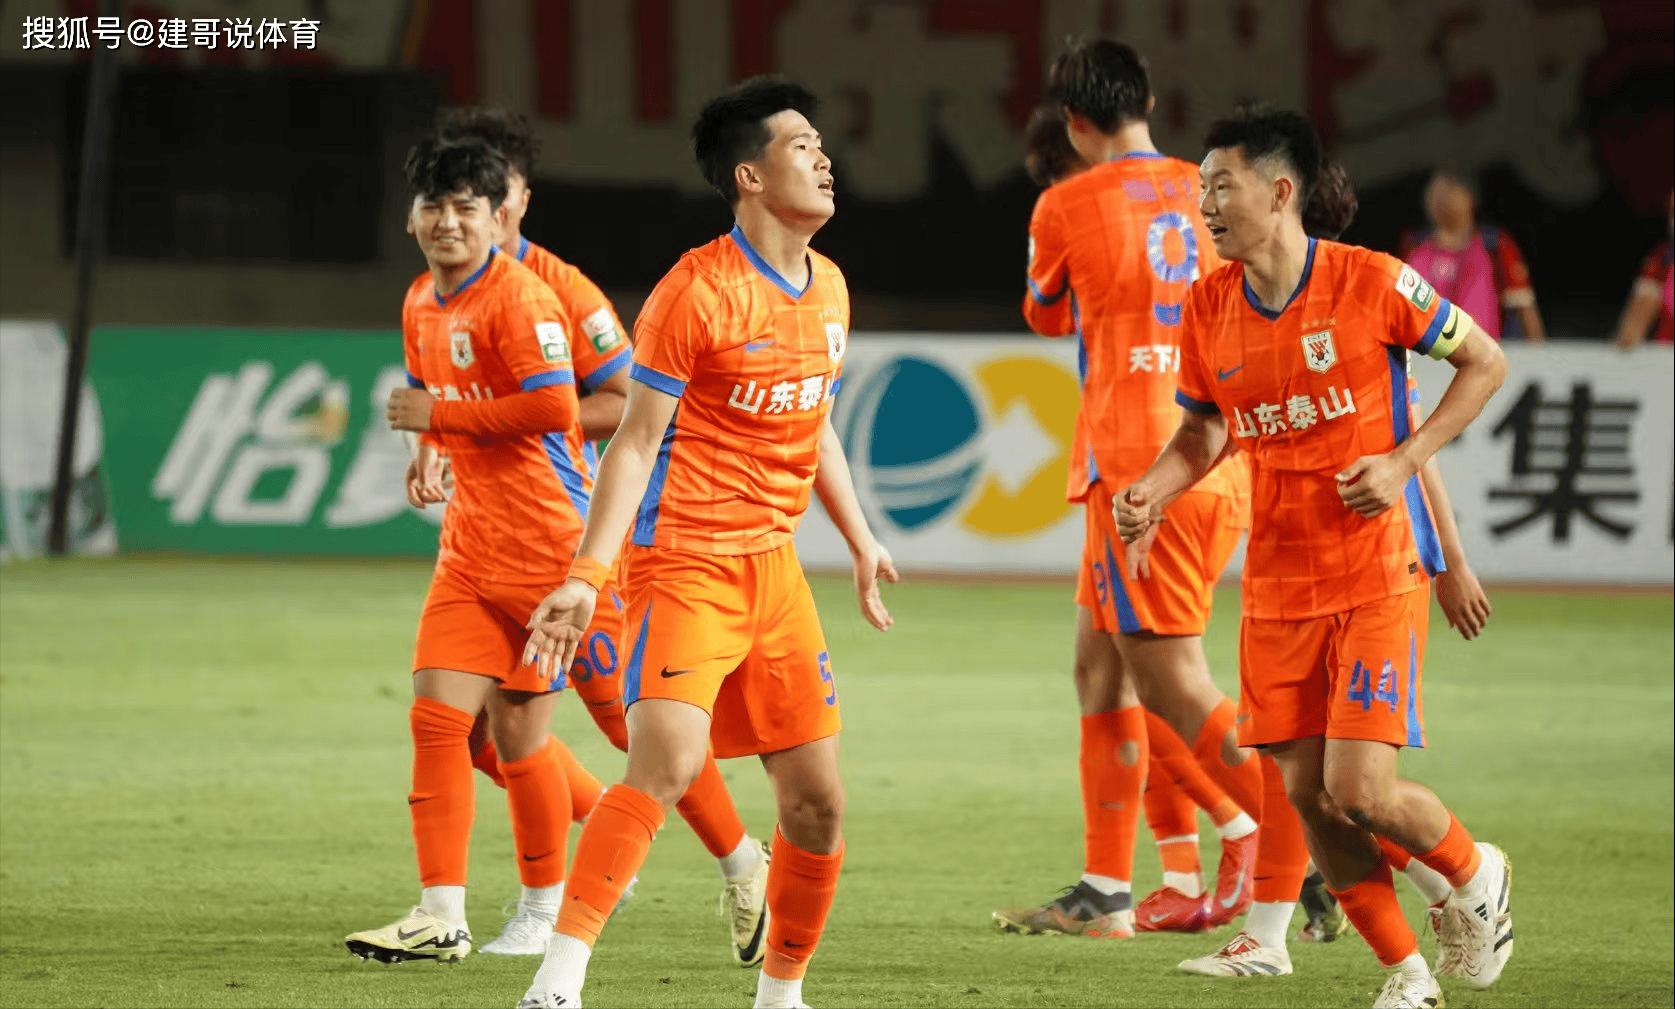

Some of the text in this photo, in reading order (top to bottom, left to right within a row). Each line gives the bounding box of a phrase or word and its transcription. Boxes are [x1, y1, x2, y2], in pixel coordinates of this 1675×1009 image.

[1146, 211, 1200, 327] 9
[1129, 344, 1181, 373] 天下
[1233, 385, 1357, 438] 山东泰山
[571, 630, 618, 683] 60
[816, 651, 837, 706] 5
[1348, 660, 1399, 712] 44
